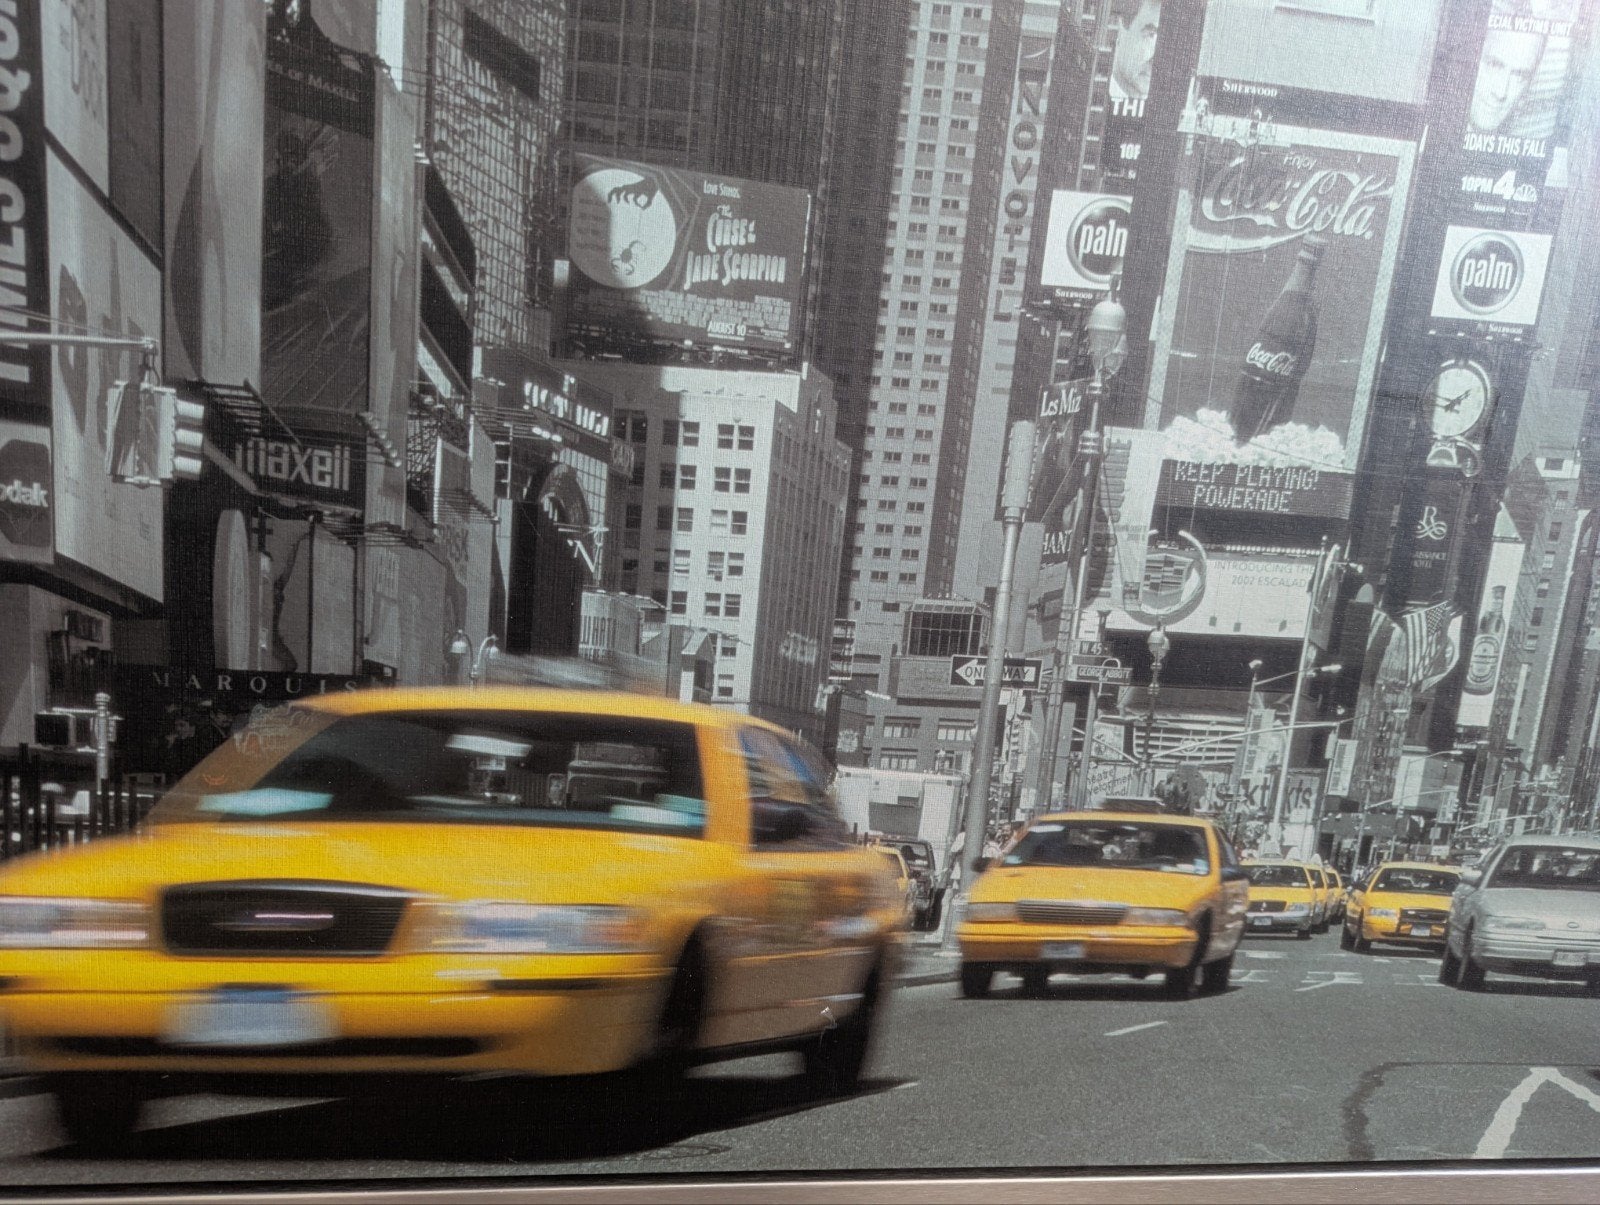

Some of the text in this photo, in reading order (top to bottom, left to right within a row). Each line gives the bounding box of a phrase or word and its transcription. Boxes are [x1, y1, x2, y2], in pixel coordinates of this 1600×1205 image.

[1497, 136, 1521, 156] THIS
[1521, 138, 1545, 158] FALL
[1461, 175, 1493, 194] 10PM
[722, 247, 786, 286] SCORPION
[1459, 253, 1513, 297] palm
[708, 320, 748, 337] AUGUST 10
[1040, 391, 1059, 417] Les
[234, 437, 351, 492] maxell
[1175, 461, 1224, 484] KEEP
[1192, 484, 1294, 512] POWERADE
[964, 665, 1031, 680] ON WAY
